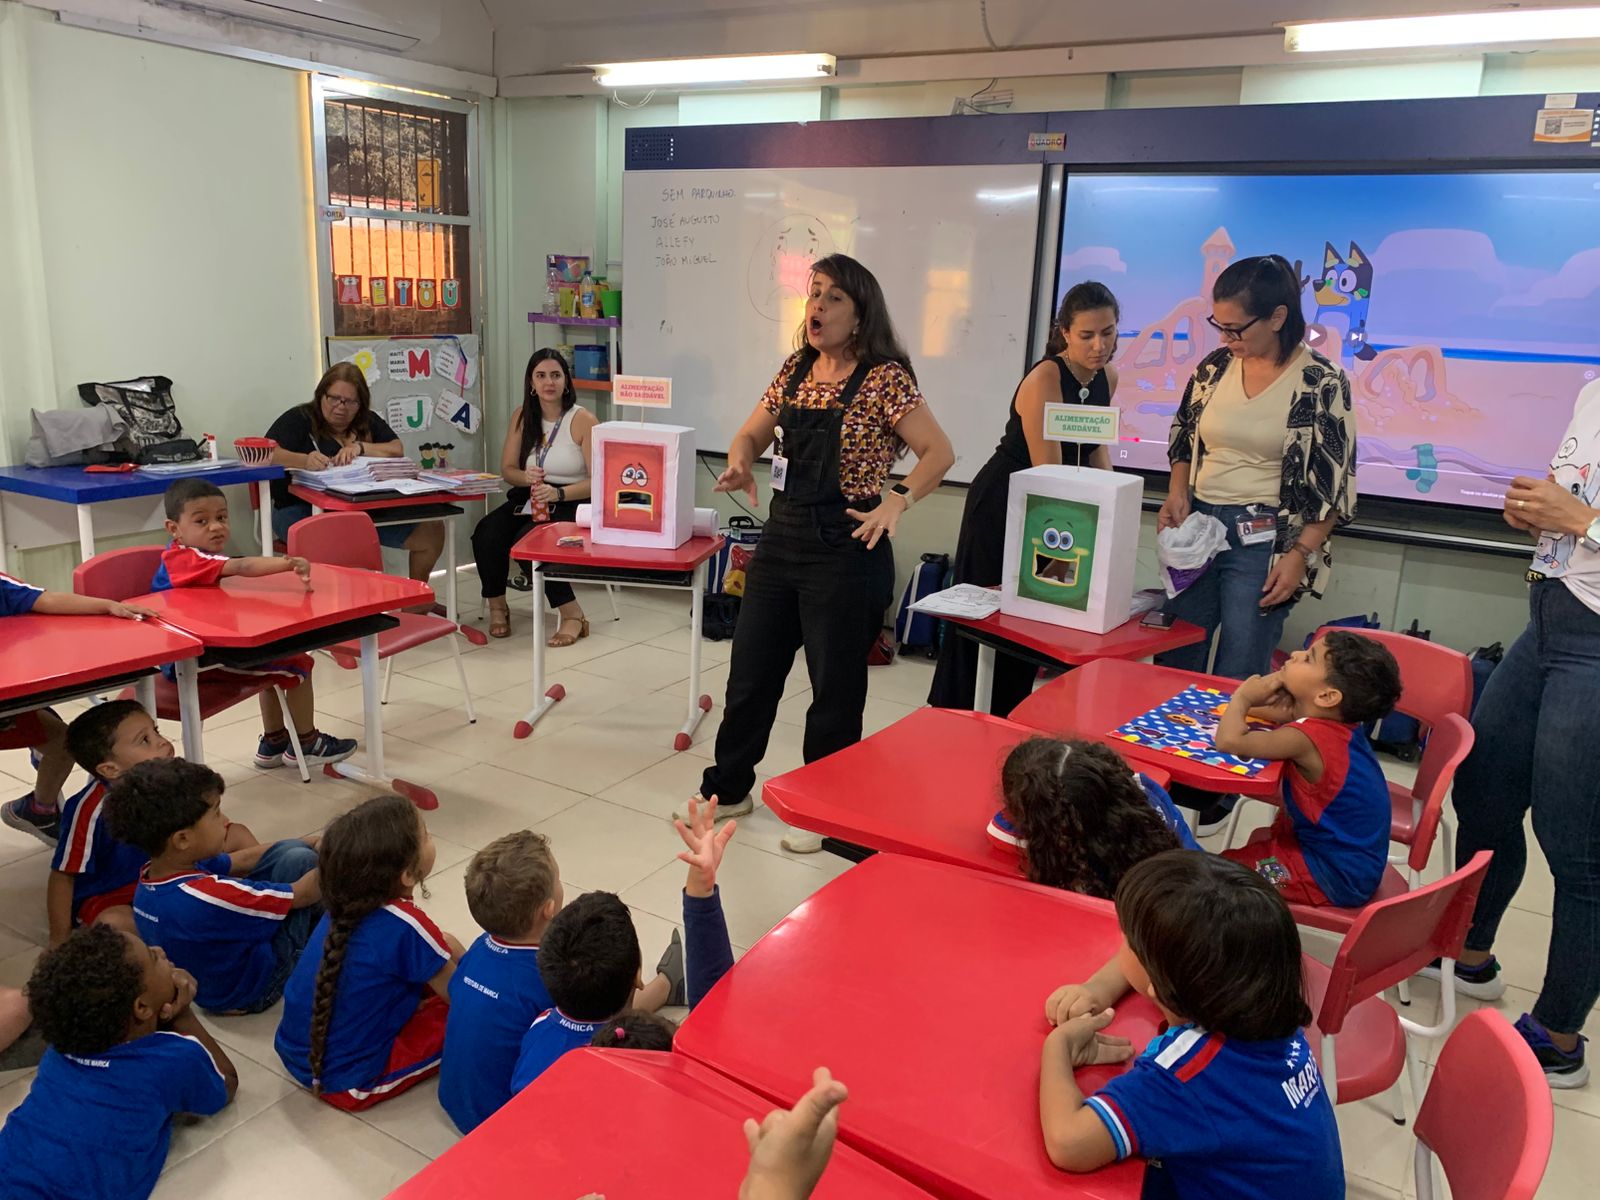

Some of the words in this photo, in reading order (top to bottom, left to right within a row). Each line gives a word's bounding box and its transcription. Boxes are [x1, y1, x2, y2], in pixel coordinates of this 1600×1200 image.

[1030, 138, 1062, 147] QUADRO
[662, 188, 684, 201] SEM
[321, 210, 343, 218] PORTA
[651, 212, 676, 228] JOSÉ
[680, 214, 720, 226] AUGUSTO
[655, 253, 677, 268] JOÃO
[681, 252, 717, 265] MIGUEL
[442, 280, 459, 307] U
[408, 349, 430, 379] M
[620, 383, 665, 392] ALIMENTAÇÃO
[634, 391, 665, 400] SAUDÁVEL
[406, 400, 423, 429] J
[450, 402, 471, 430] A
[1054, 414, 1111, 425] ALIMENTAÇÃO
[1062, 424, 1102, 433] SAUDÁVEL
